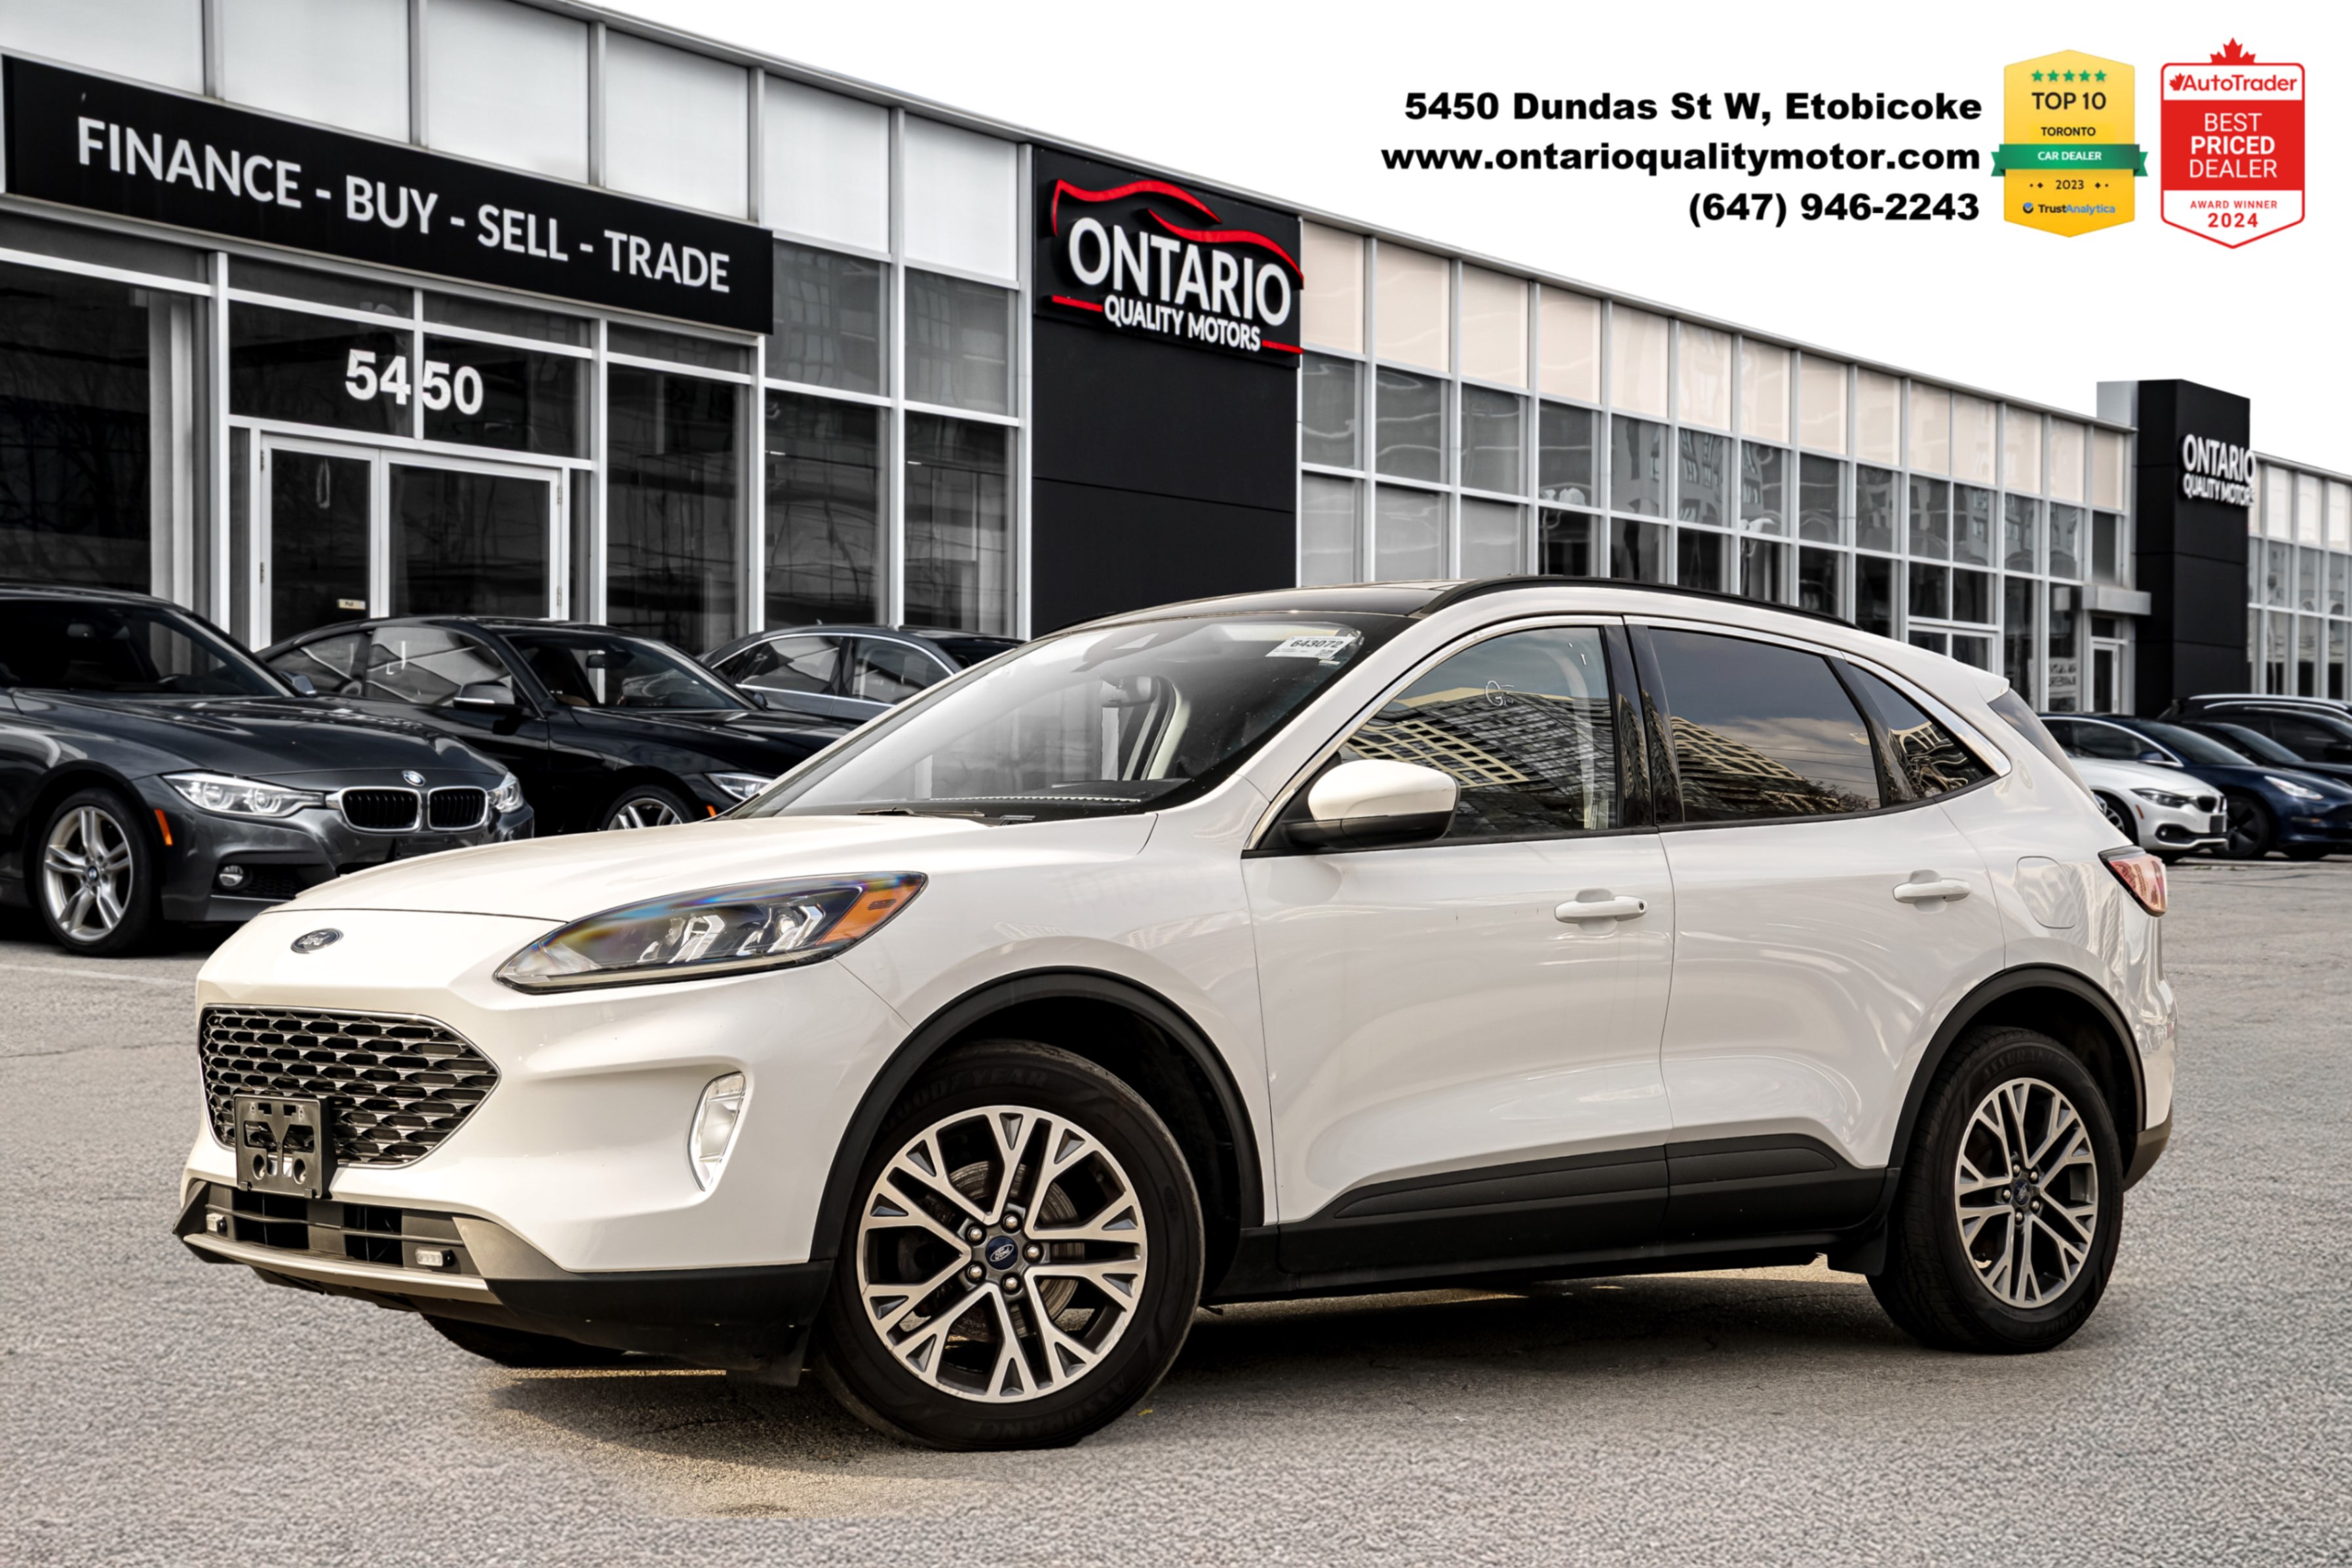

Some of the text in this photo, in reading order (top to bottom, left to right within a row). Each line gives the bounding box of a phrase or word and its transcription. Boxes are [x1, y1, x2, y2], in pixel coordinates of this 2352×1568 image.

[78, 116, 301, 208] FINANCE
[346, 175, 438, 234] BUY
[478, 204, 568, 261] SELL
[604, 229, 729, 293] TRADE
[1069, 217, 1291, 326] ONTARIO
[1104, 294, 1261, 352] QUALITY MOTORS
[345, 349, 484, 415] 5450
[2183, 434, 2256, 485] ONTARIO
[2183, 473, 2255, 507] QUALITY MOTORS
[1290, 640, 1344, 648] 643072
